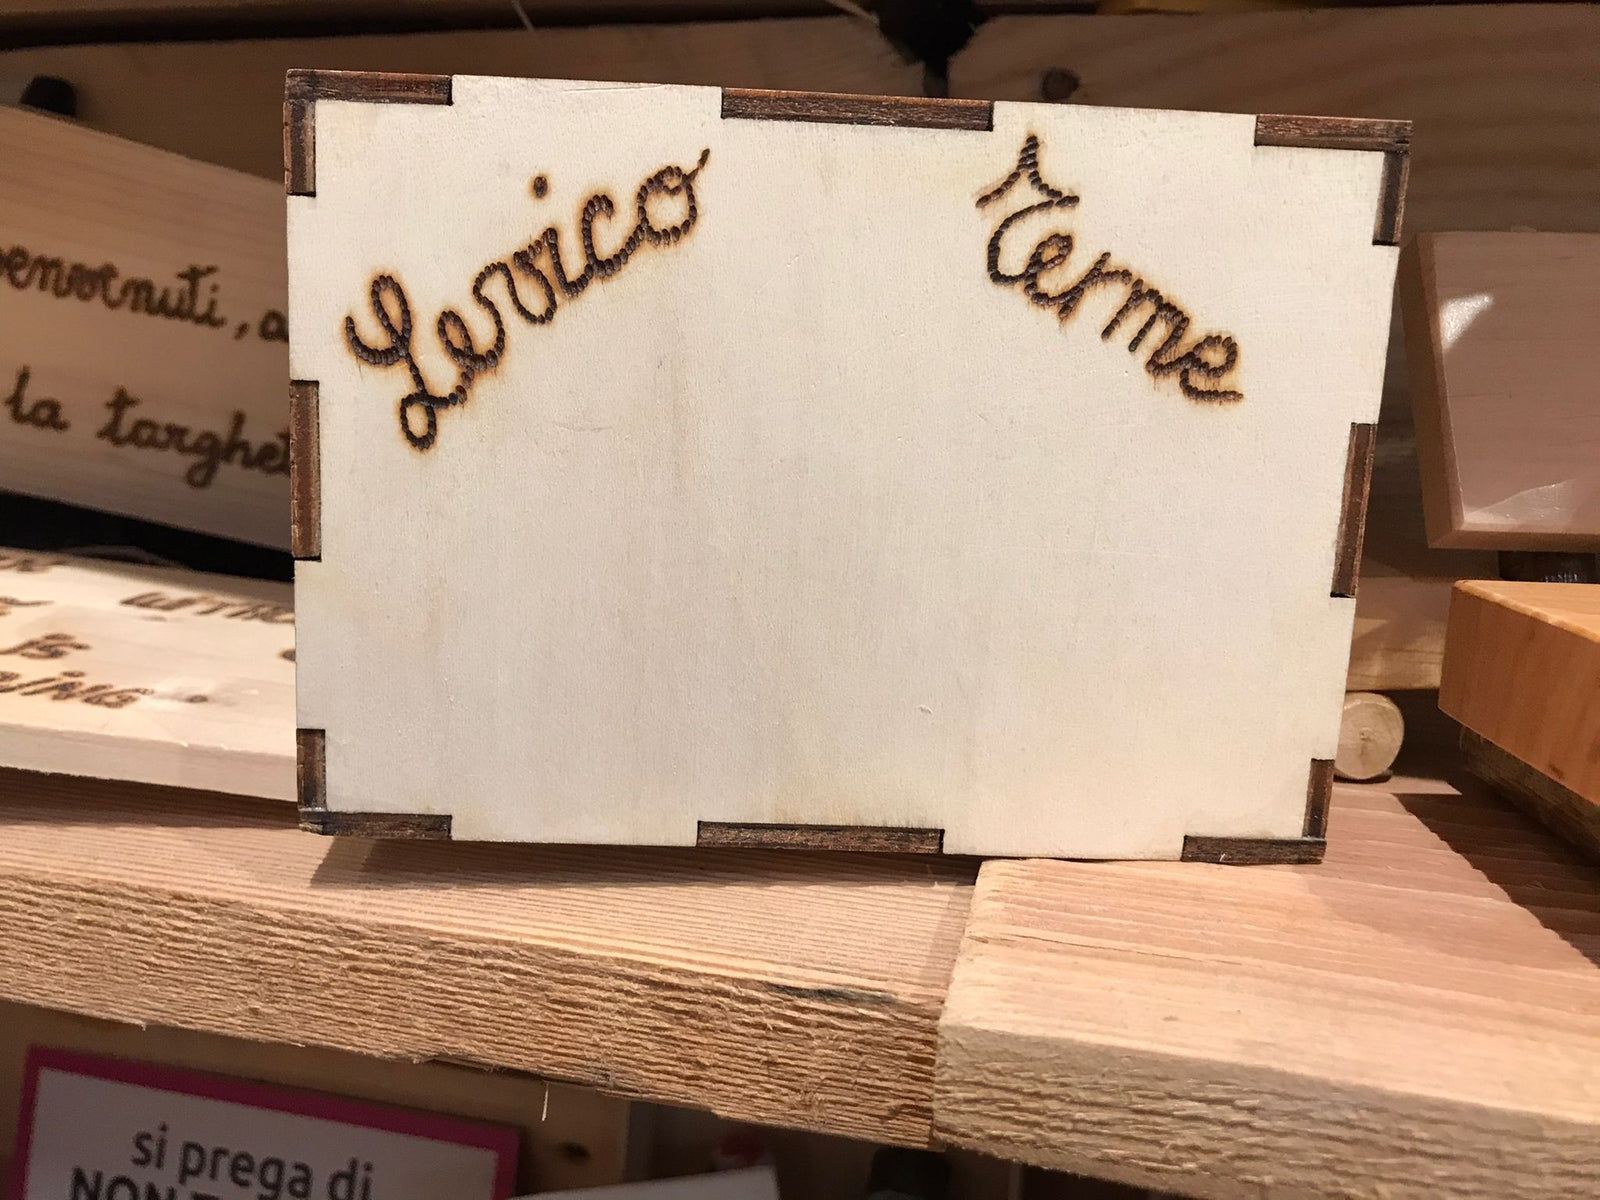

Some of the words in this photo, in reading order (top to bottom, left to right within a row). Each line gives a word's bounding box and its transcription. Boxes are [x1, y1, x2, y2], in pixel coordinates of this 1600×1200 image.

[345, 148, 711, 451] Levico
[975, 134, 1244, 402] Terme
[4, 364, 71, 432] la
[131, 1121, 169, 1169] si
[178, 1139, 314, 1200] prega
[327, 1155, 374, 1200] di
